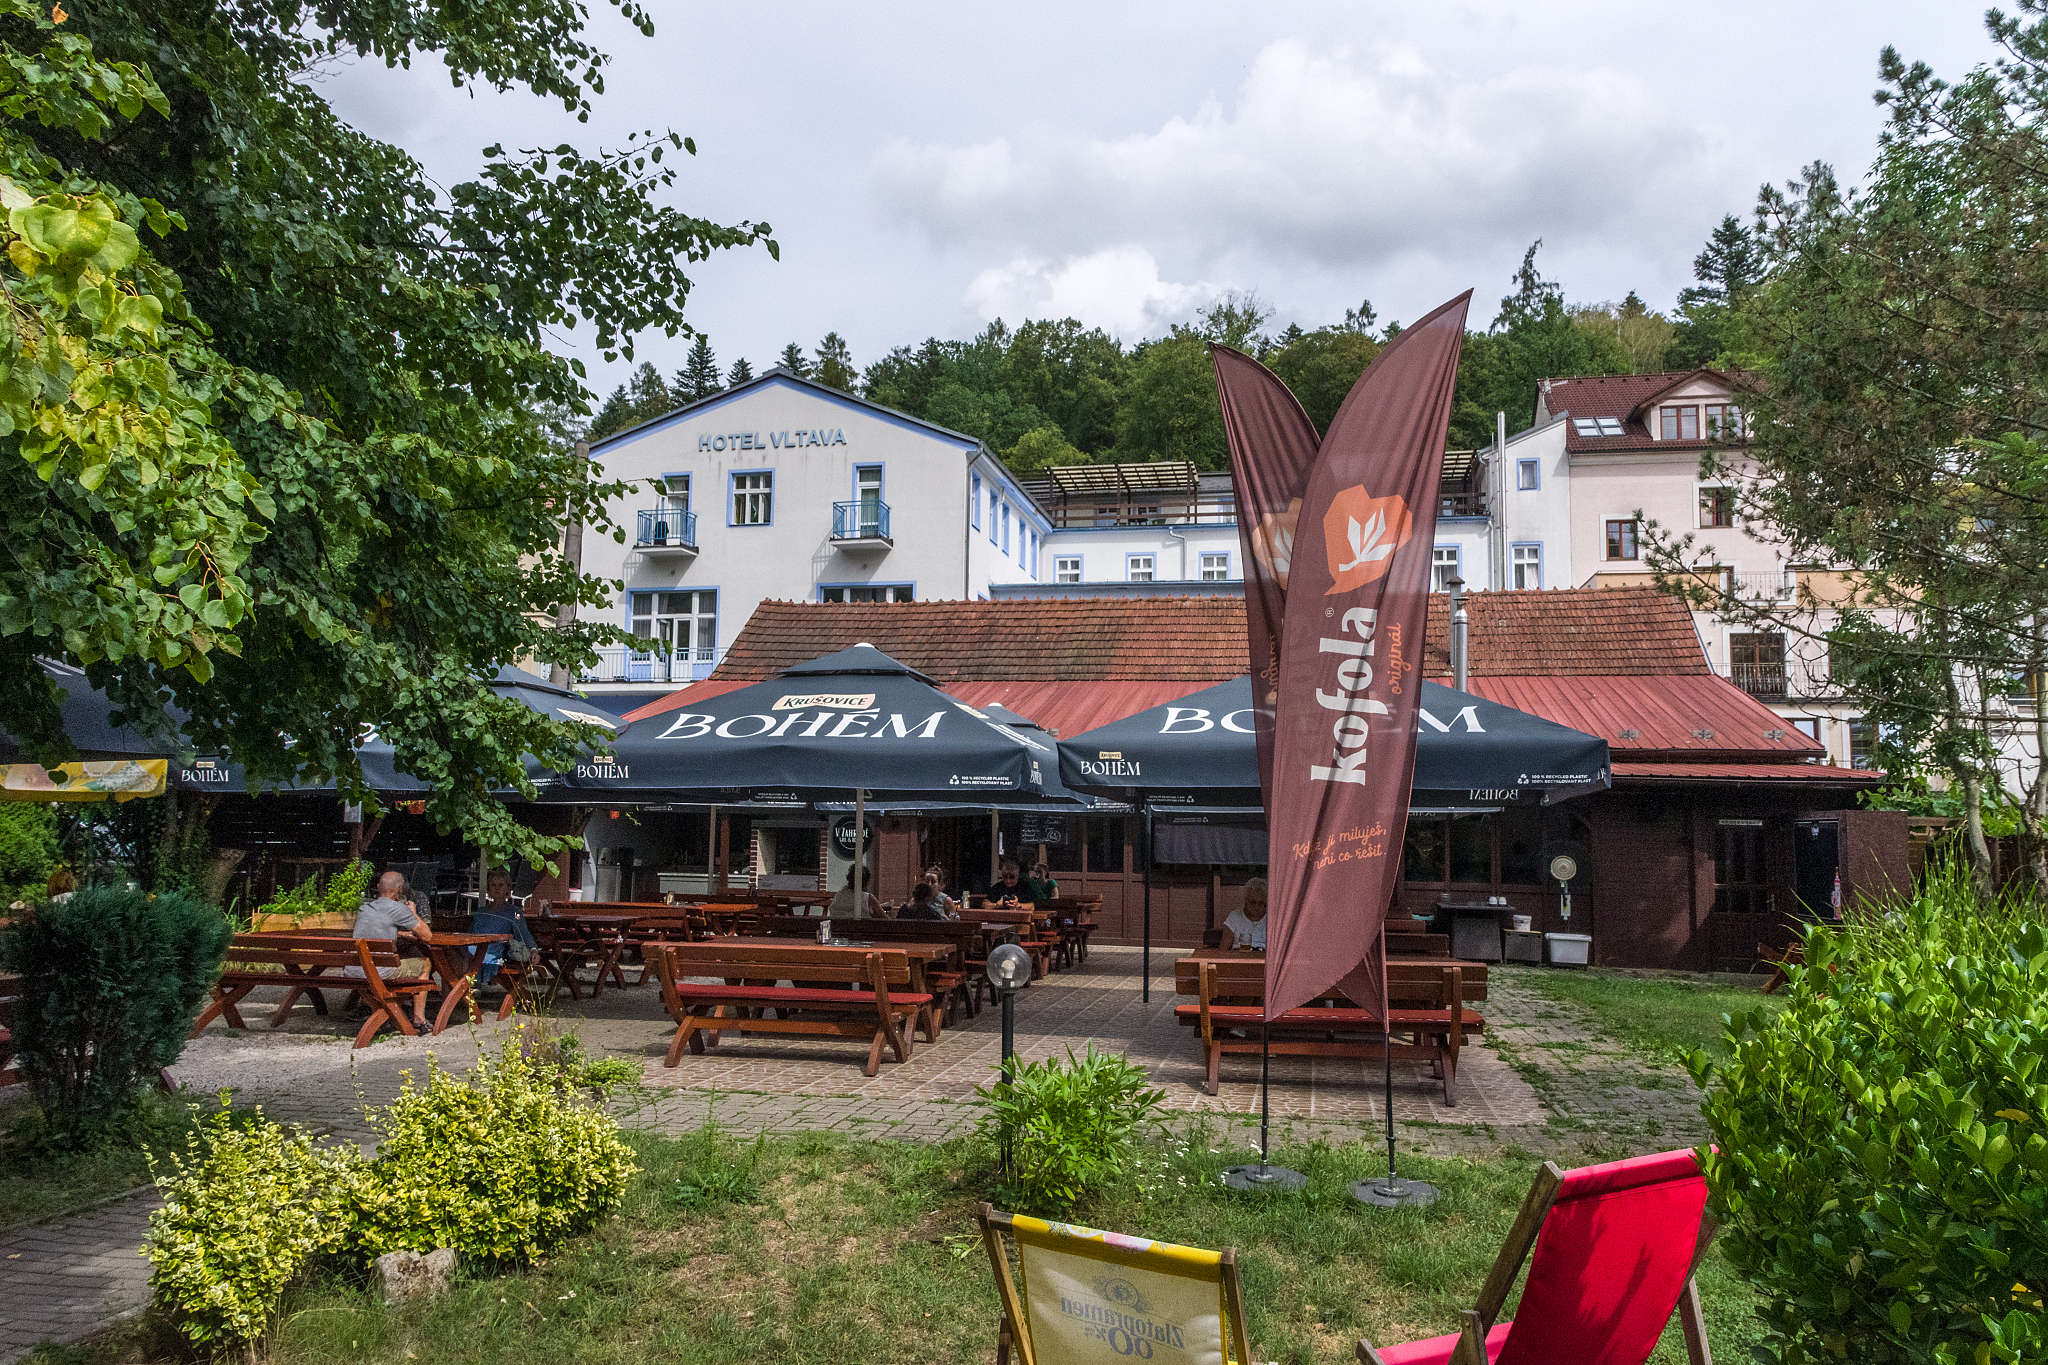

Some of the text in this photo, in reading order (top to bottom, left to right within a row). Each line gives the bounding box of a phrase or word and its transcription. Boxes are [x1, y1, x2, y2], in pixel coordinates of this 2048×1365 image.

[699, 428, 847, 452] HOTEL VLTAVA
[1387, 622, 1412, 694] originál
[1311, 607, 1388, 786] kofola
[655, 708, 947, 739] BOHÉM
[182, 768, 229, 782] BOHÉM
[577, 763, 629, 778] BOHÉM
[1081, 759, 1141, 776] BOHÉM
[1292, 821, 1387, 861] Kdž ji miluješ,
[1313, 852, 1336, 870] není
[1338, 852, 1353, 862] co
